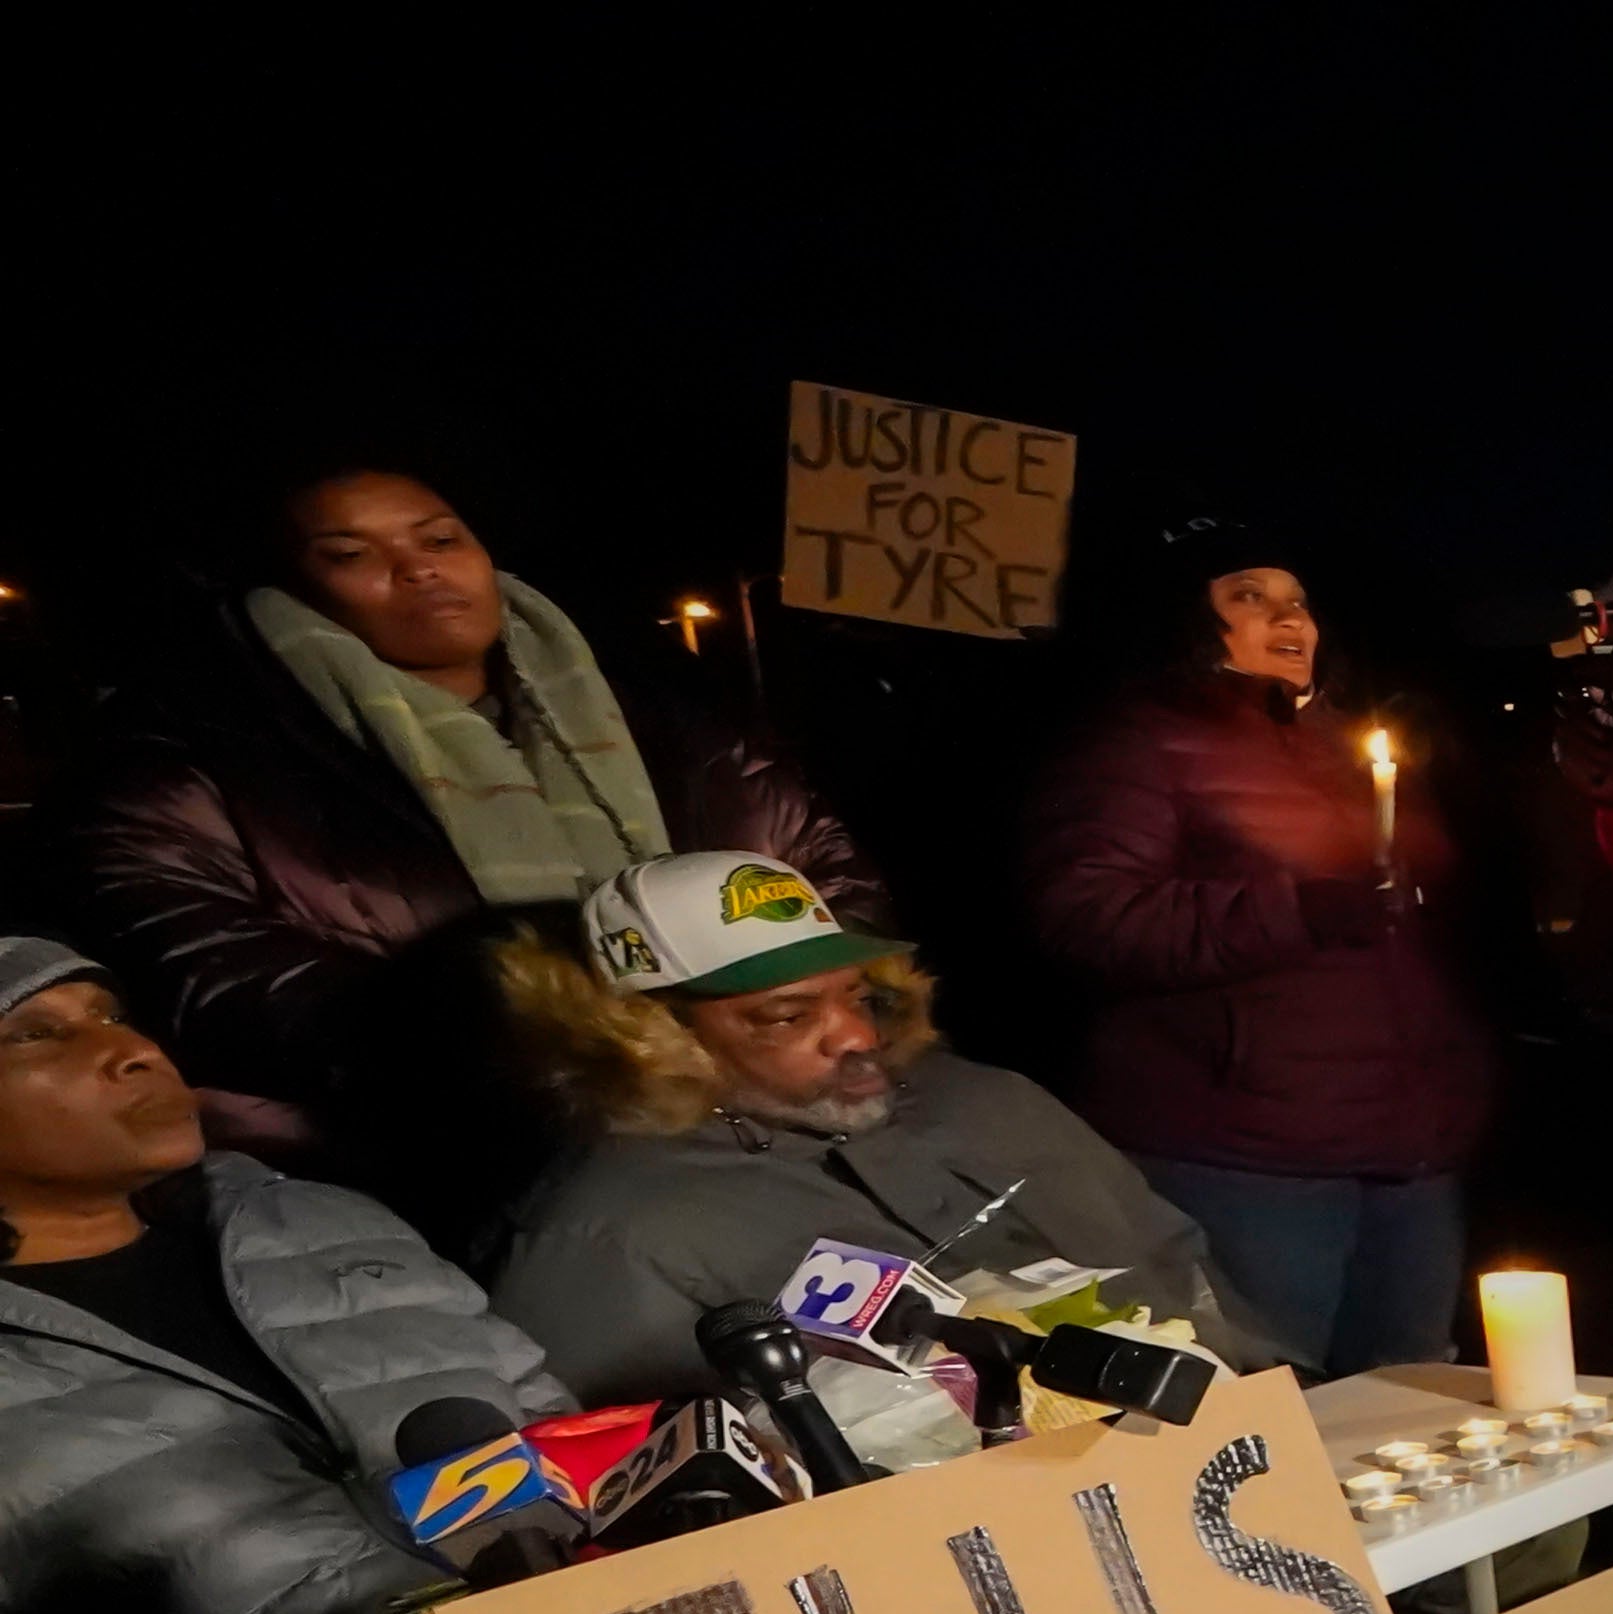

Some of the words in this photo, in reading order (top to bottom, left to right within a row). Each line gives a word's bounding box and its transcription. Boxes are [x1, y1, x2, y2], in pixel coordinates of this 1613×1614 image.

[791, 390, 1066, 499] JUSTICE
[866, 482, 996, 560] FOR
[796, 525, 1049, 629] TYRE
[781, 1251, 881, 1325] 3
[852, 1268, 900, 1328] WREG.COM
[413, 1431, 530, 1542] 5
[629, 1424, 678, 1496] 24
